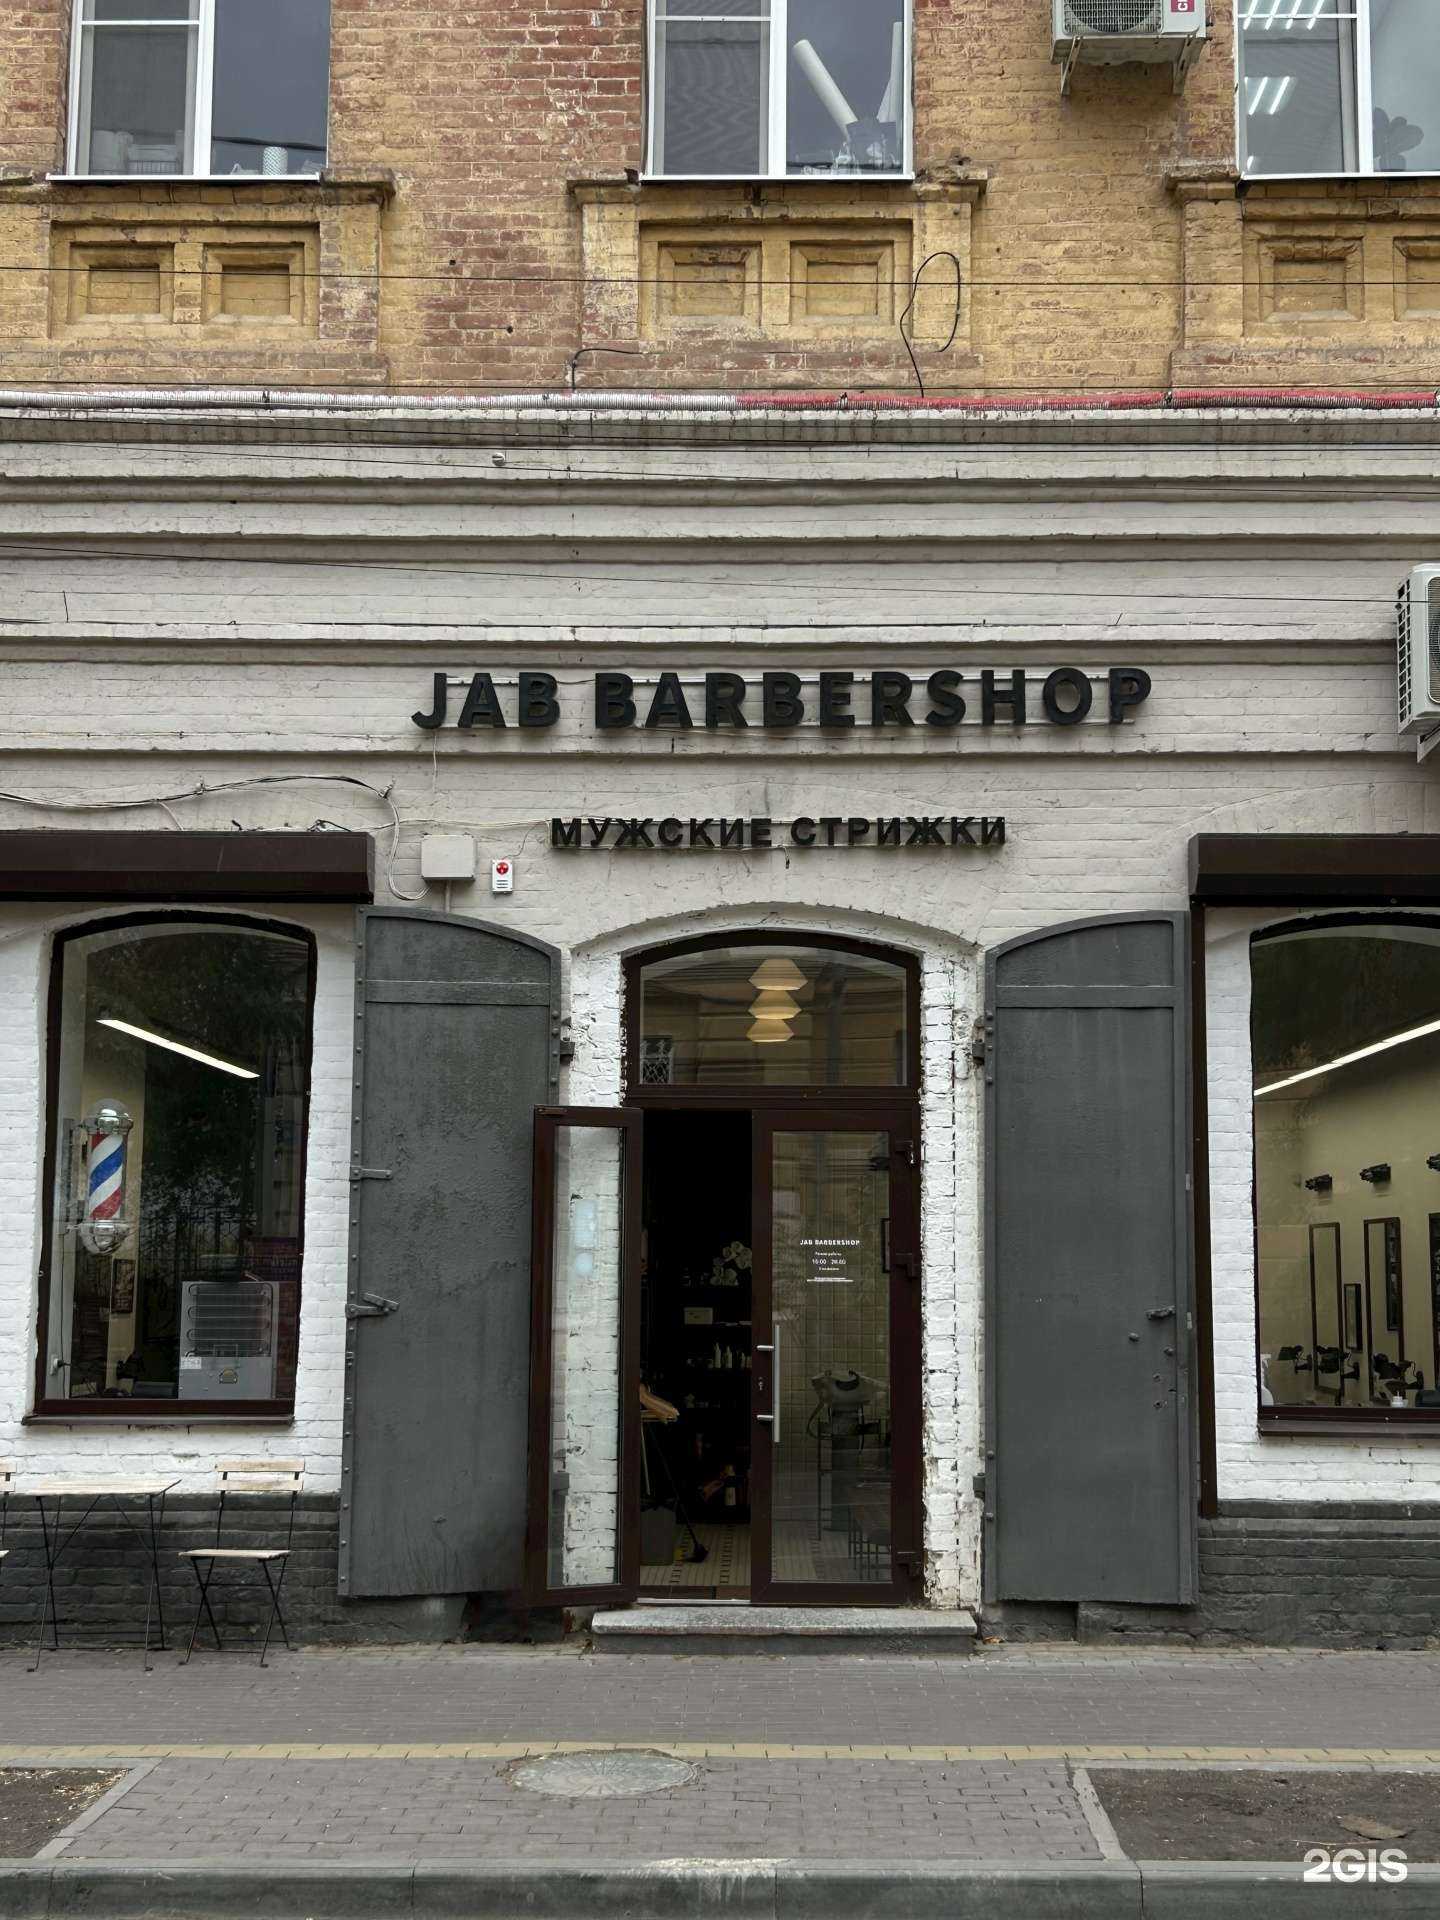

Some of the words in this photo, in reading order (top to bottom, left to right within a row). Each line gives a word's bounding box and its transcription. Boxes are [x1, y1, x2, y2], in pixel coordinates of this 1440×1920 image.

[411, 671, 559, 729] JAB
[595, 667, 1152, 729] BARBERSHOP
[551, 817, 773, 848] МУЖСКИЕ
[790, 817, 1007, 848] СТРИЖКИ
